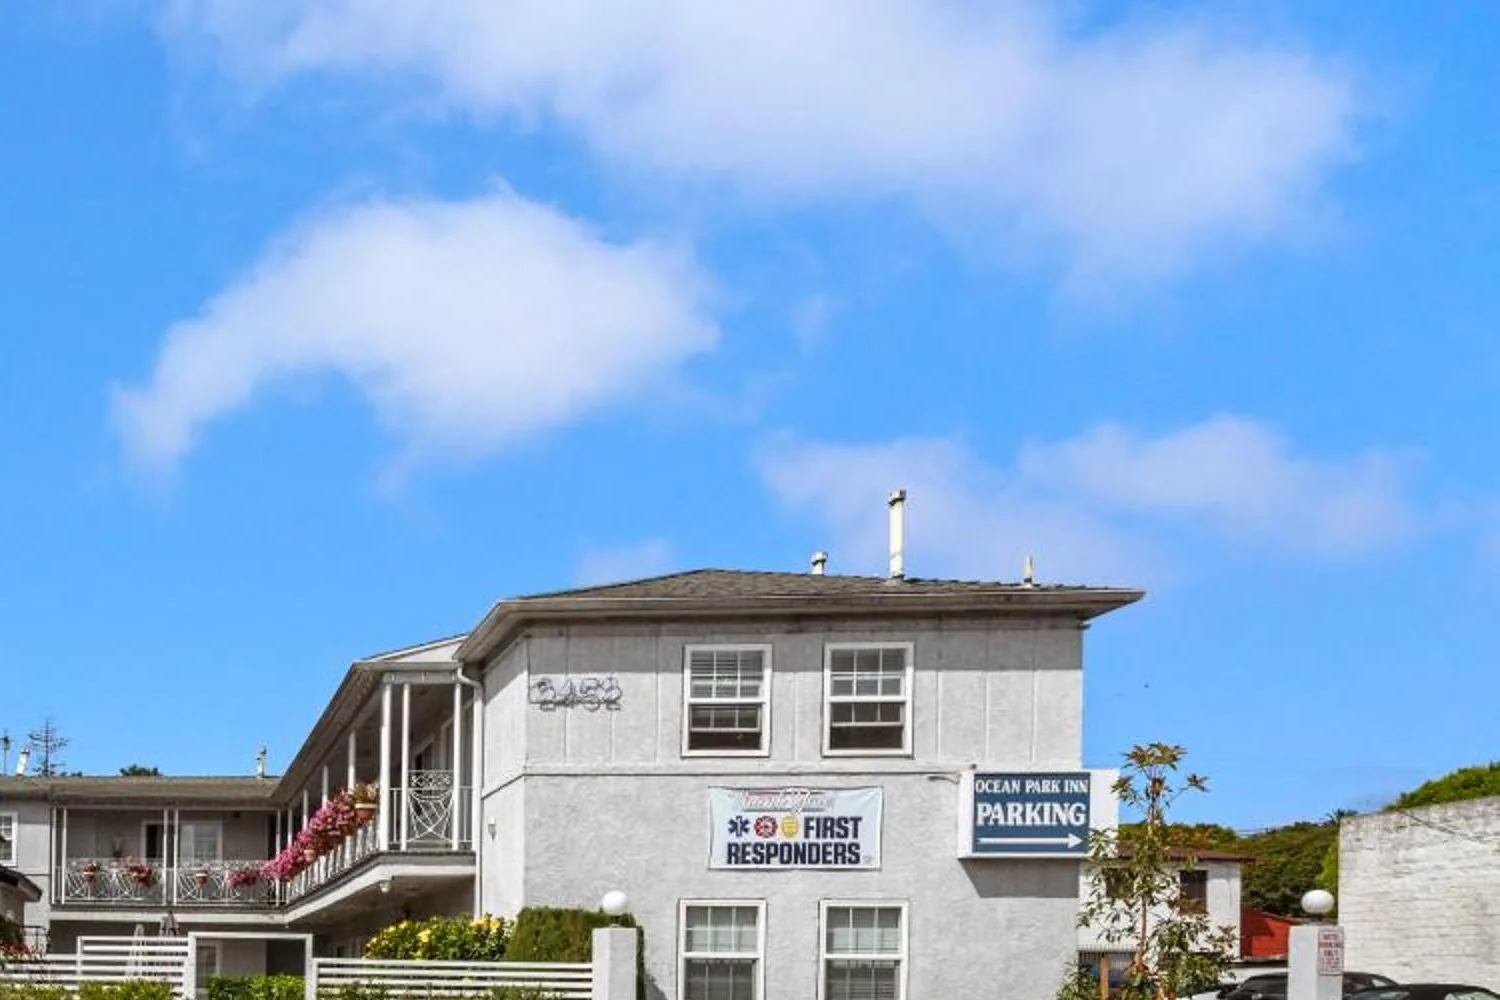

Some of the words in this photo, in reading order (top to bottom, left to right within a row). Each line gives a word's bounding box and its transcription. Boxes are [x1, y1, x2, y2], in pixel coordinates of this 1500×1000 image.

[975, 779, 1021, 794] OCEAN
[1025, 779, 1061, 794] PARK
[1063, 779, 1089, 794] INN
[976, 801, 1086, 827] PARKING
[803, 816, 862, 839] FIRST
[726, 842, 861, 865] RESPONDERS
